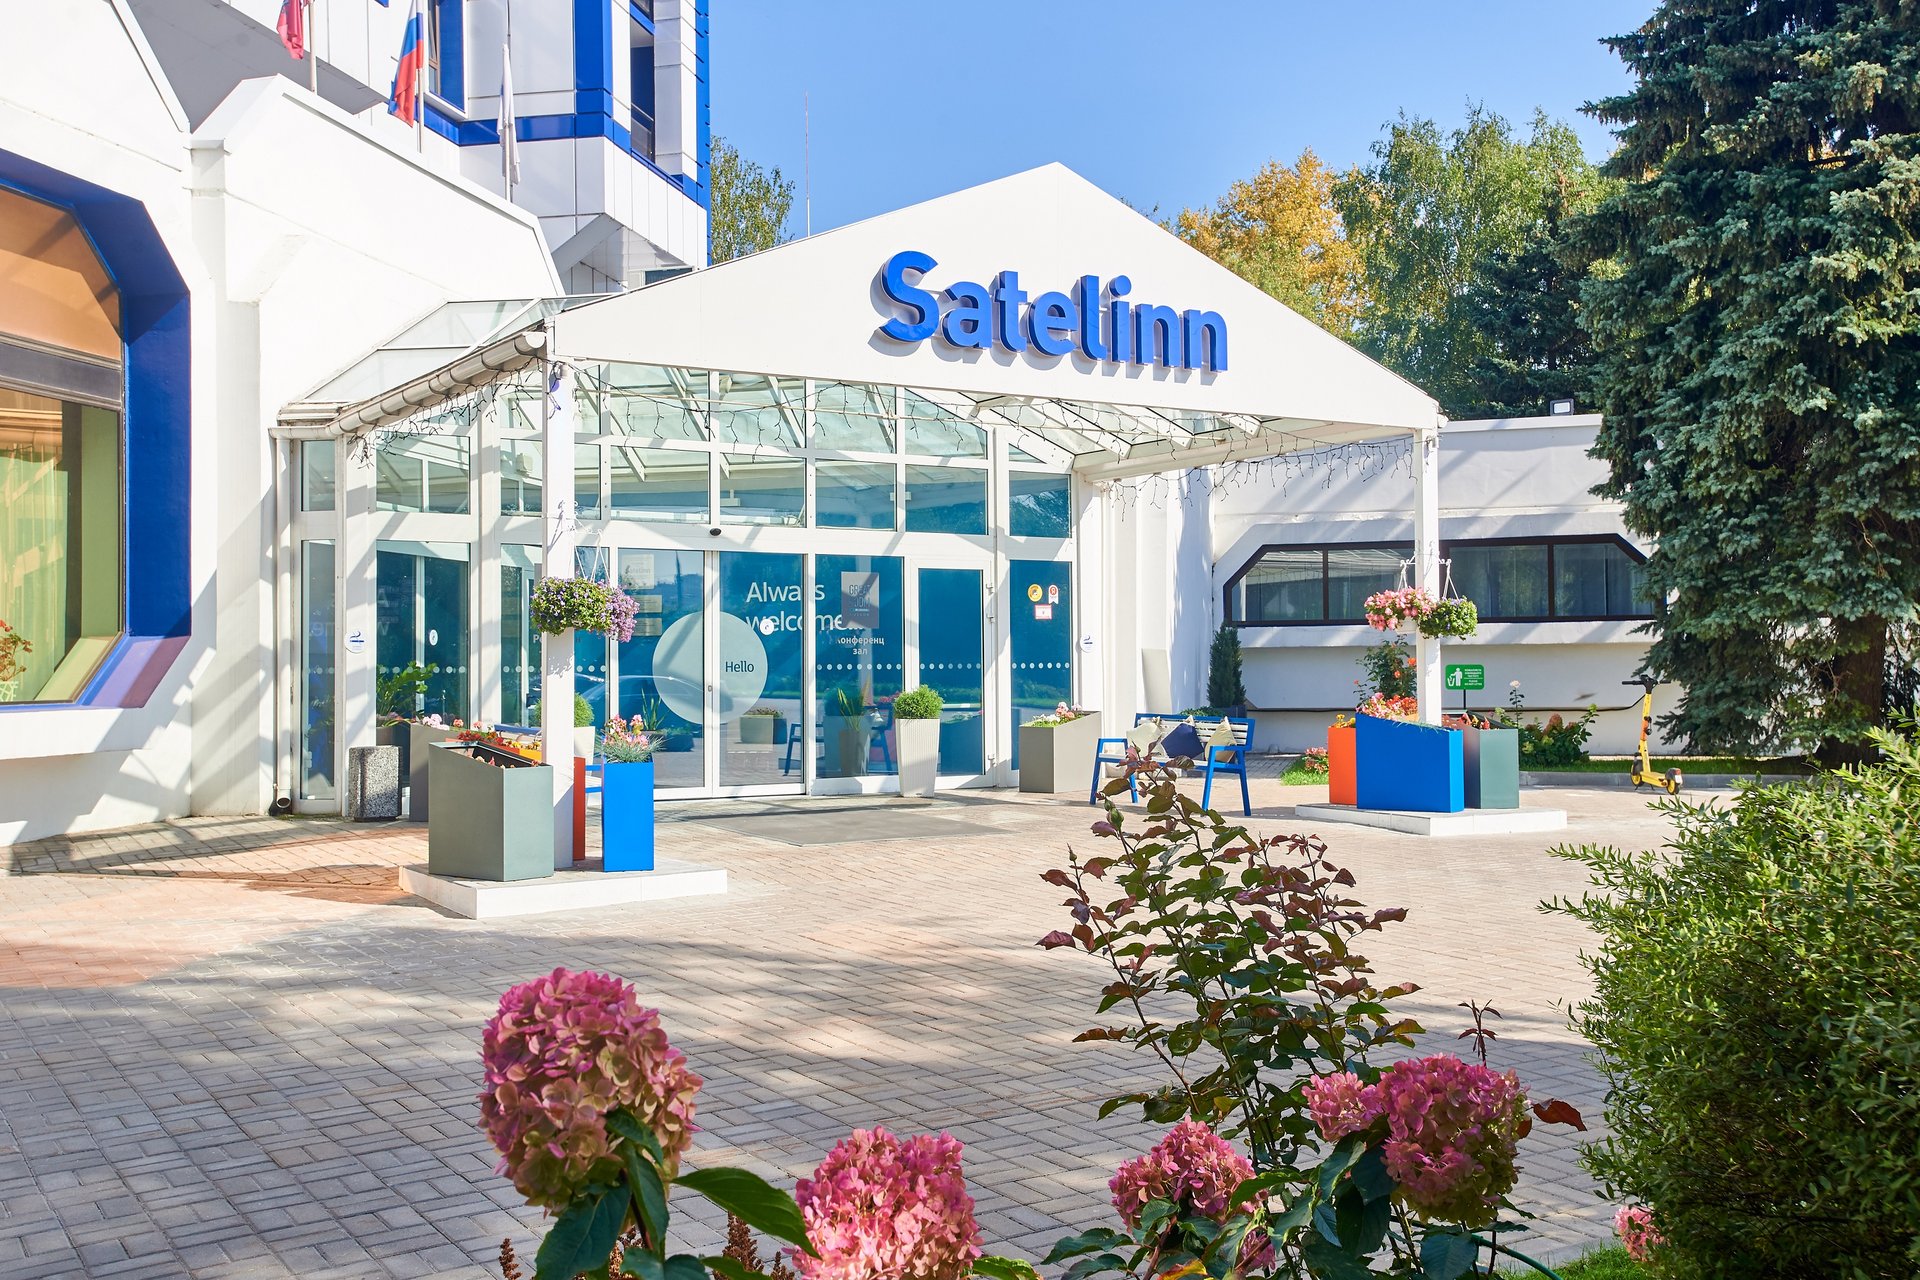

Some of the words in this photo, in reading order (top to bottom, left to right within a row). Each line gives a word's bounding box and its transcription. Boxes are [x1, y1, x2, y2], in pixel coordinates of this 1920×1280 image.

[878, 250, 1228, 372] Satelinn
[746, 581, 826, 602] Alwas
[725, 660, 755, 673] Hello
